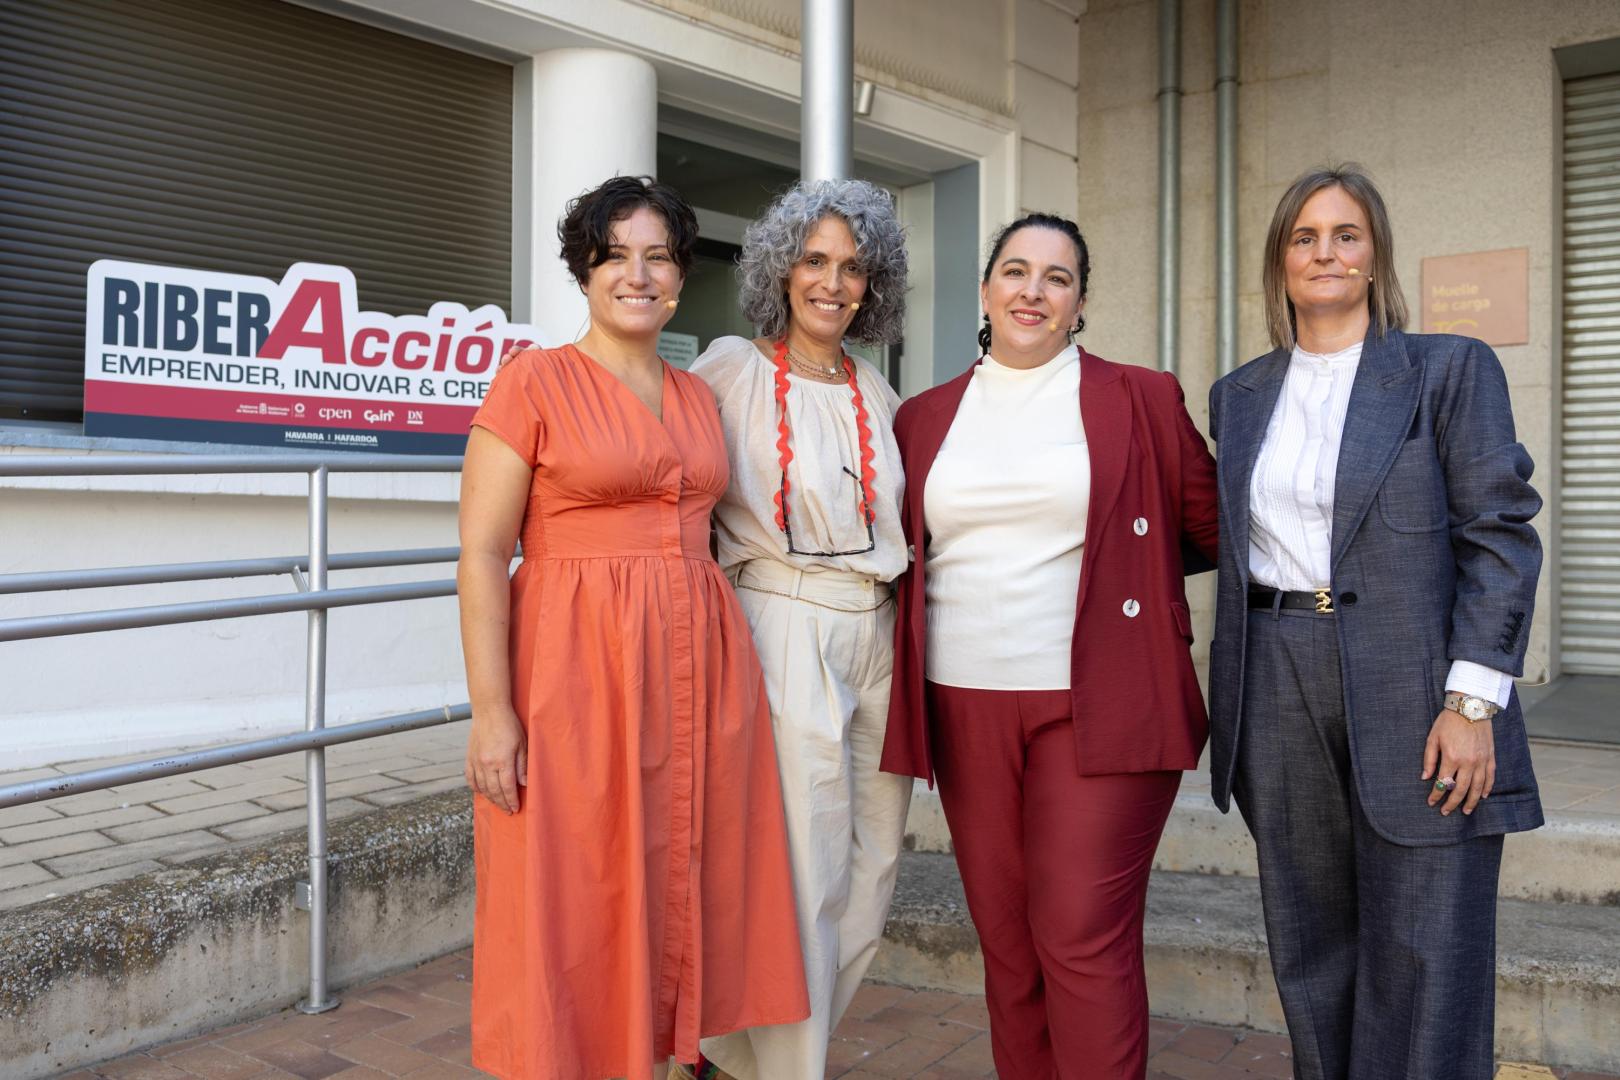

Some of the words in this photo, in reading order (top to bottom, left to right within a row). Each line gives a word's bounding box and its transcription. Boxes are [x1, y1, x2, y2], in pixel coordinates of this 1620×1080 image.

[101, 354, 286, 390] EMPRENDER,
[294, 372, 411, 396] INNOVAR
[419, 379, 436, 396] &
[444, 380, 490, 399] CRE
[285, 431, 325, 441] NAVARRA
